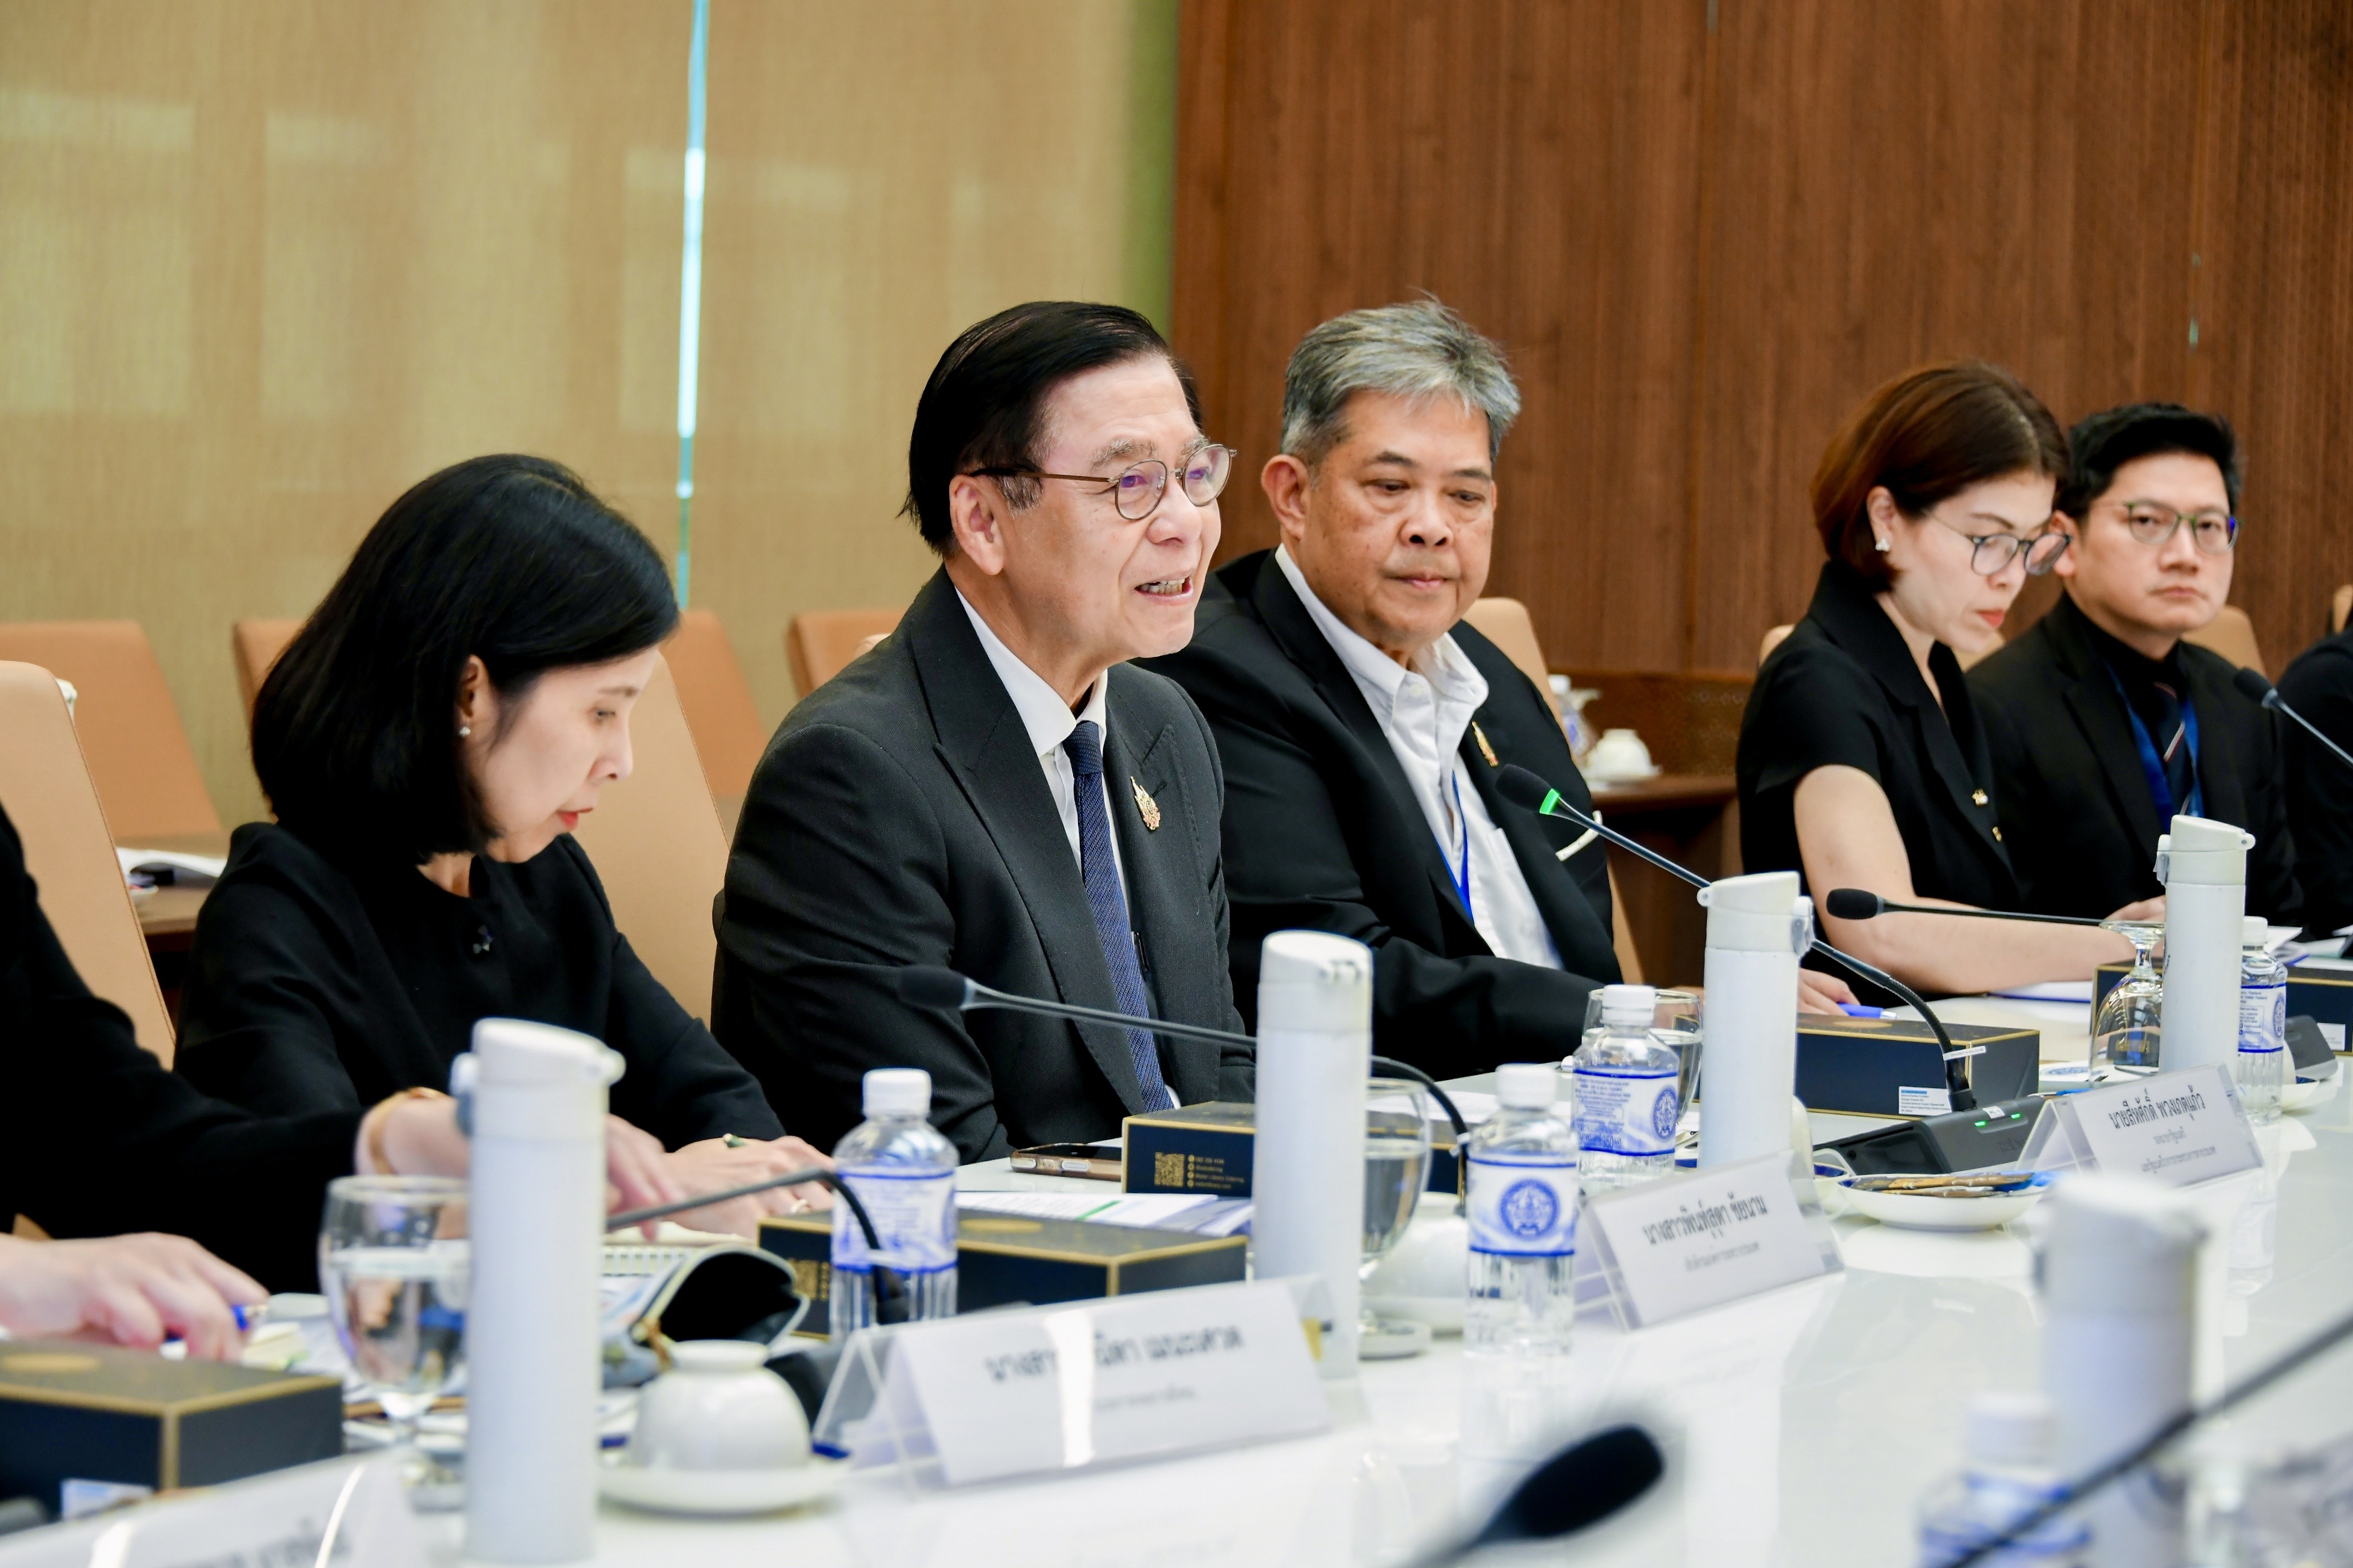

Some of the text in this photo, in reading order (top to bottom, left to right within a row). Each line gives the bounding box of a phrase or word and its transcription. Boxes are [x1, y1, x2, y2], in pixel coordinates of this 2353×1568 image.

[2108, 1084, 2206, 1129] นายสีหศักดิ์ พวงเกตุแก้ว
[1727, 1191, 1767, 1221] ชัยนาม
